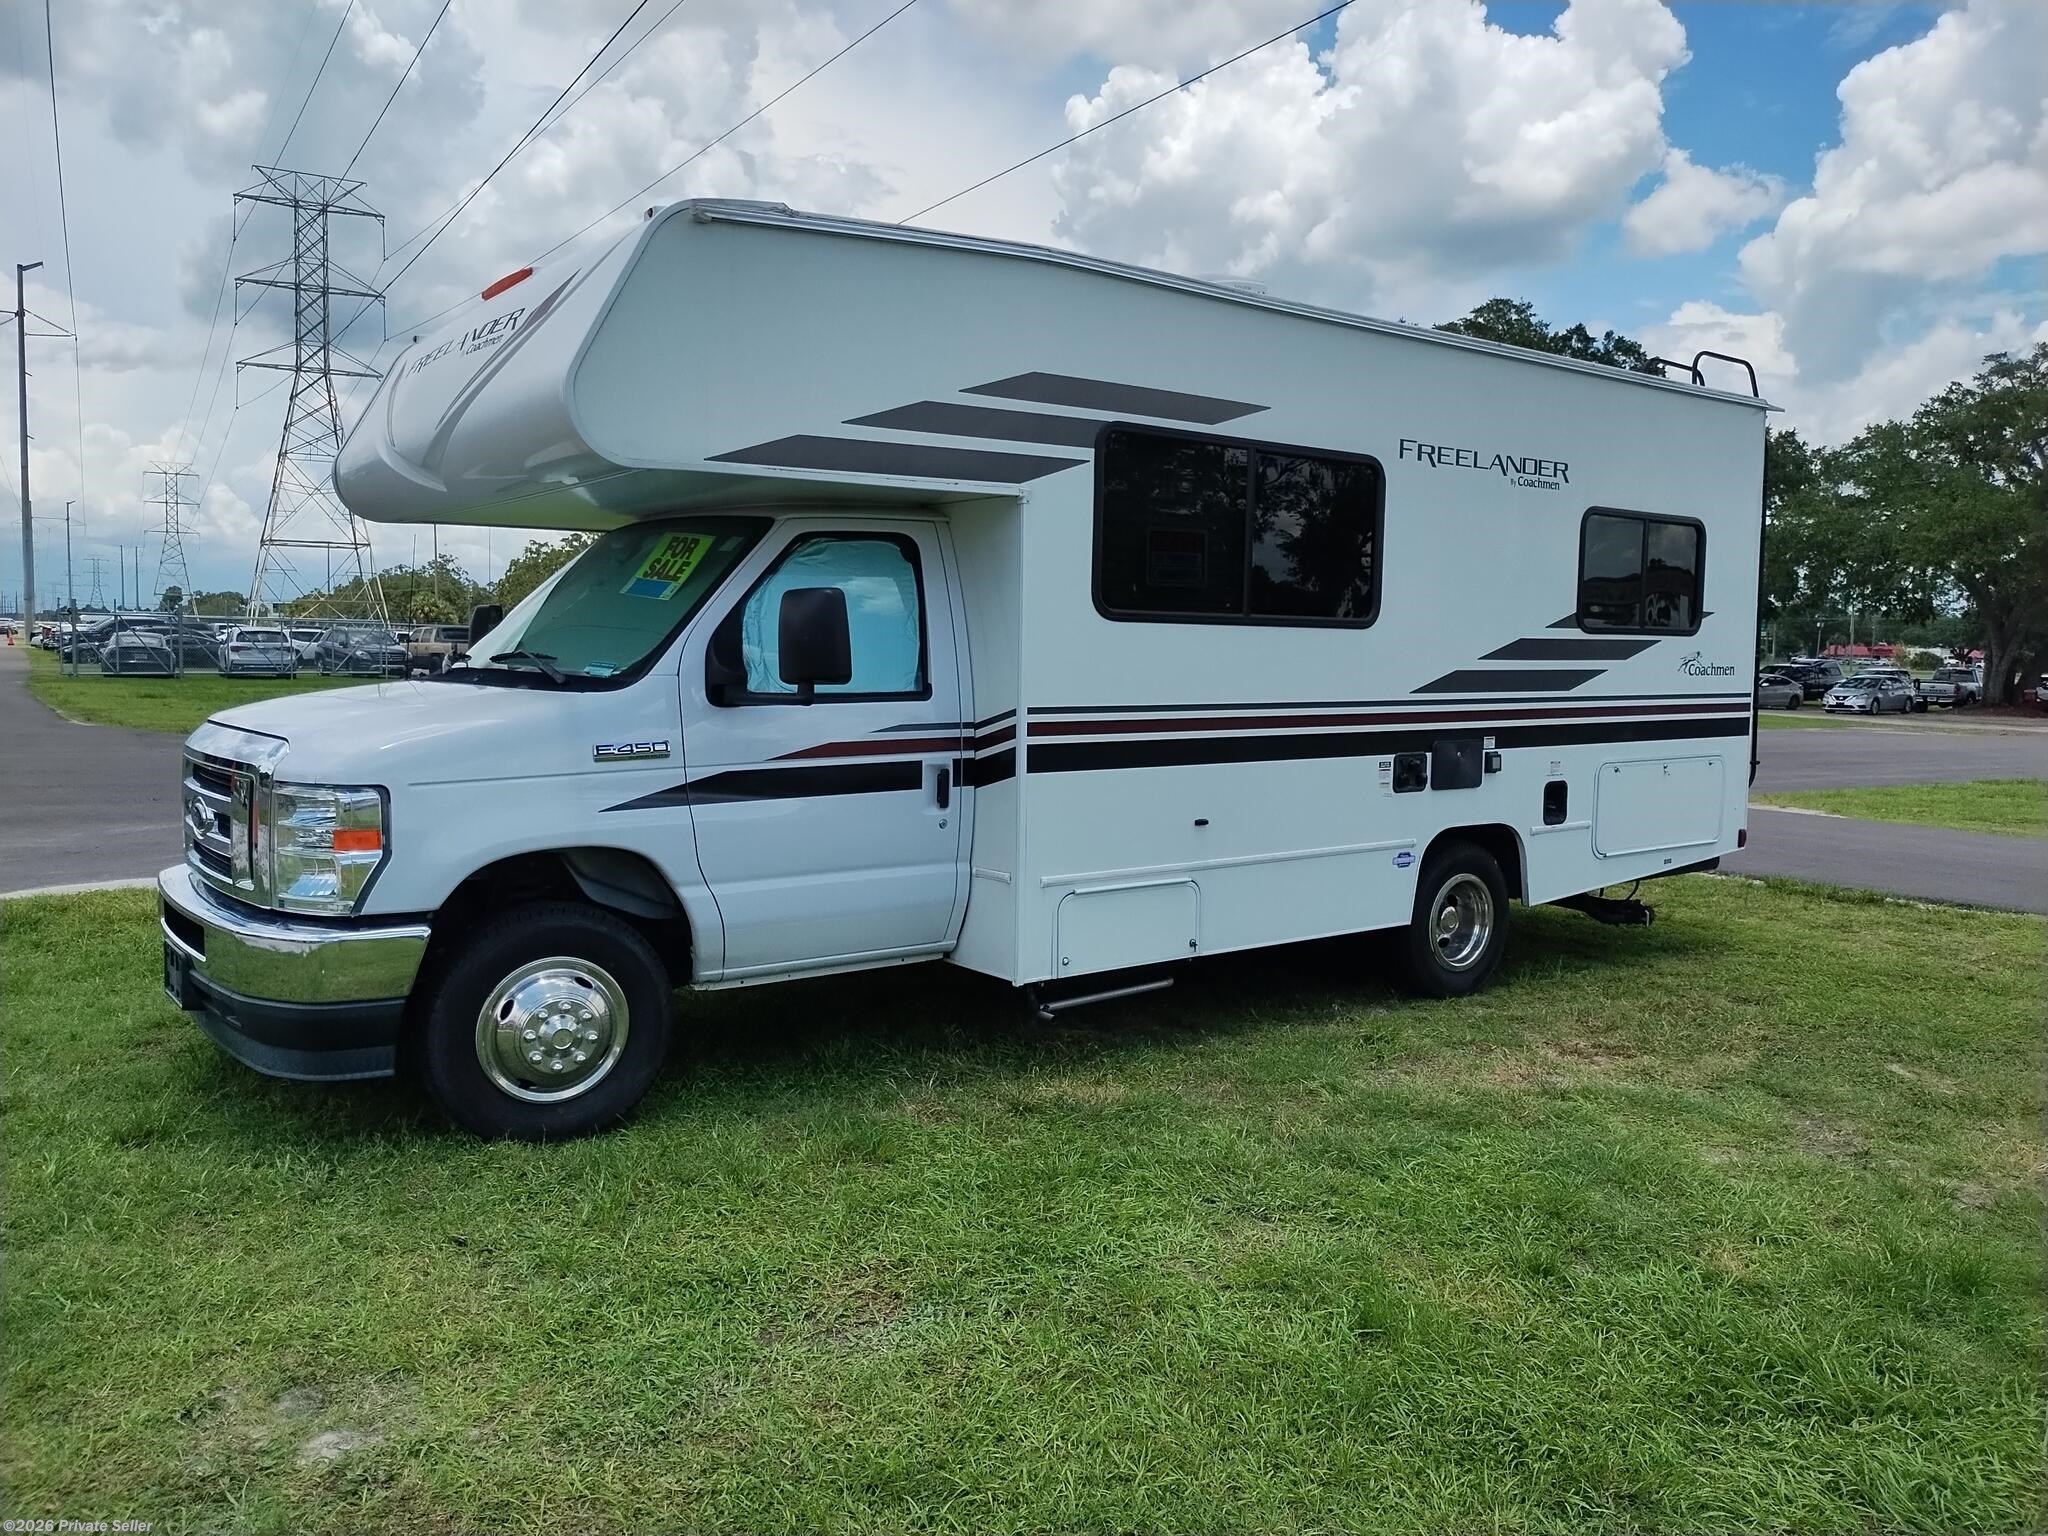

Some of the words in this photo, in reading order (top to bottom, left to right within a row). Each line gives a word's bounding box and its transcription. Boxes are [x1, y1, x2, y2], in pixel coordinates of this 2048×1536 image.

[1399, 438, 1570, 484] FREELANDER
[1517, 475, 1560, 491] Coachmen
[660, 535, 701, 560] FOR
[642, 557, 692, 582] SALE
[1688, 661, 1735, 676] Coachmen
